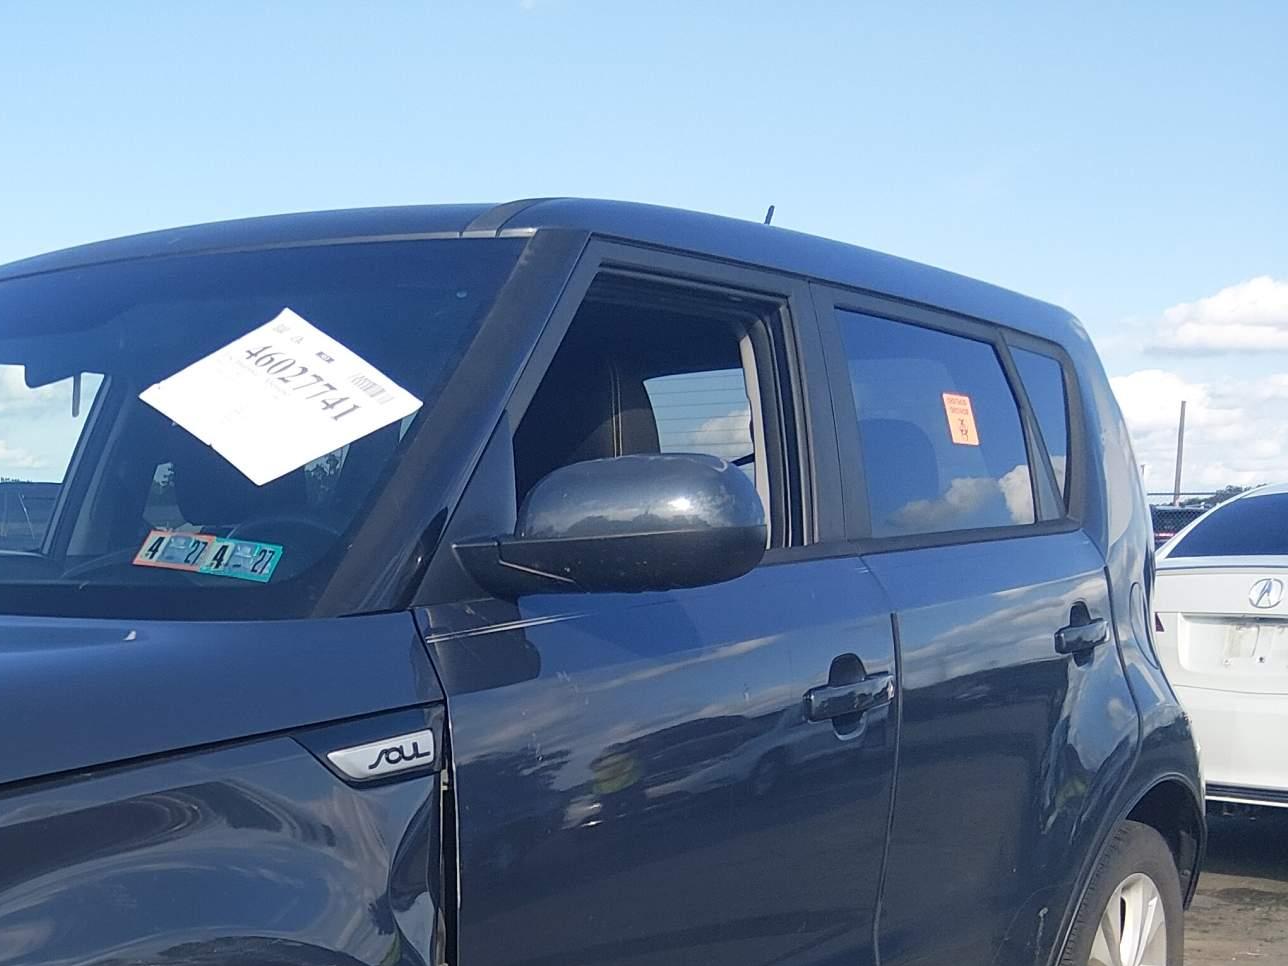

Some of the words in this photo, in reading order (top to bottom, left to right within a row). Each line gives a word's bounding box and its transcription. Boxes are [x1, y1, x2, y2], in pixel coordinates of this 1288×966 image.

[244, 345, 363, 421] 46027741
[147, 536, 165, 560] 4
[184, 539, 209, 566] 27
[211, 544, 229, 569] 4
[250, 548, 275, 574] 27
[368, 741, 431, 770] SOUL
